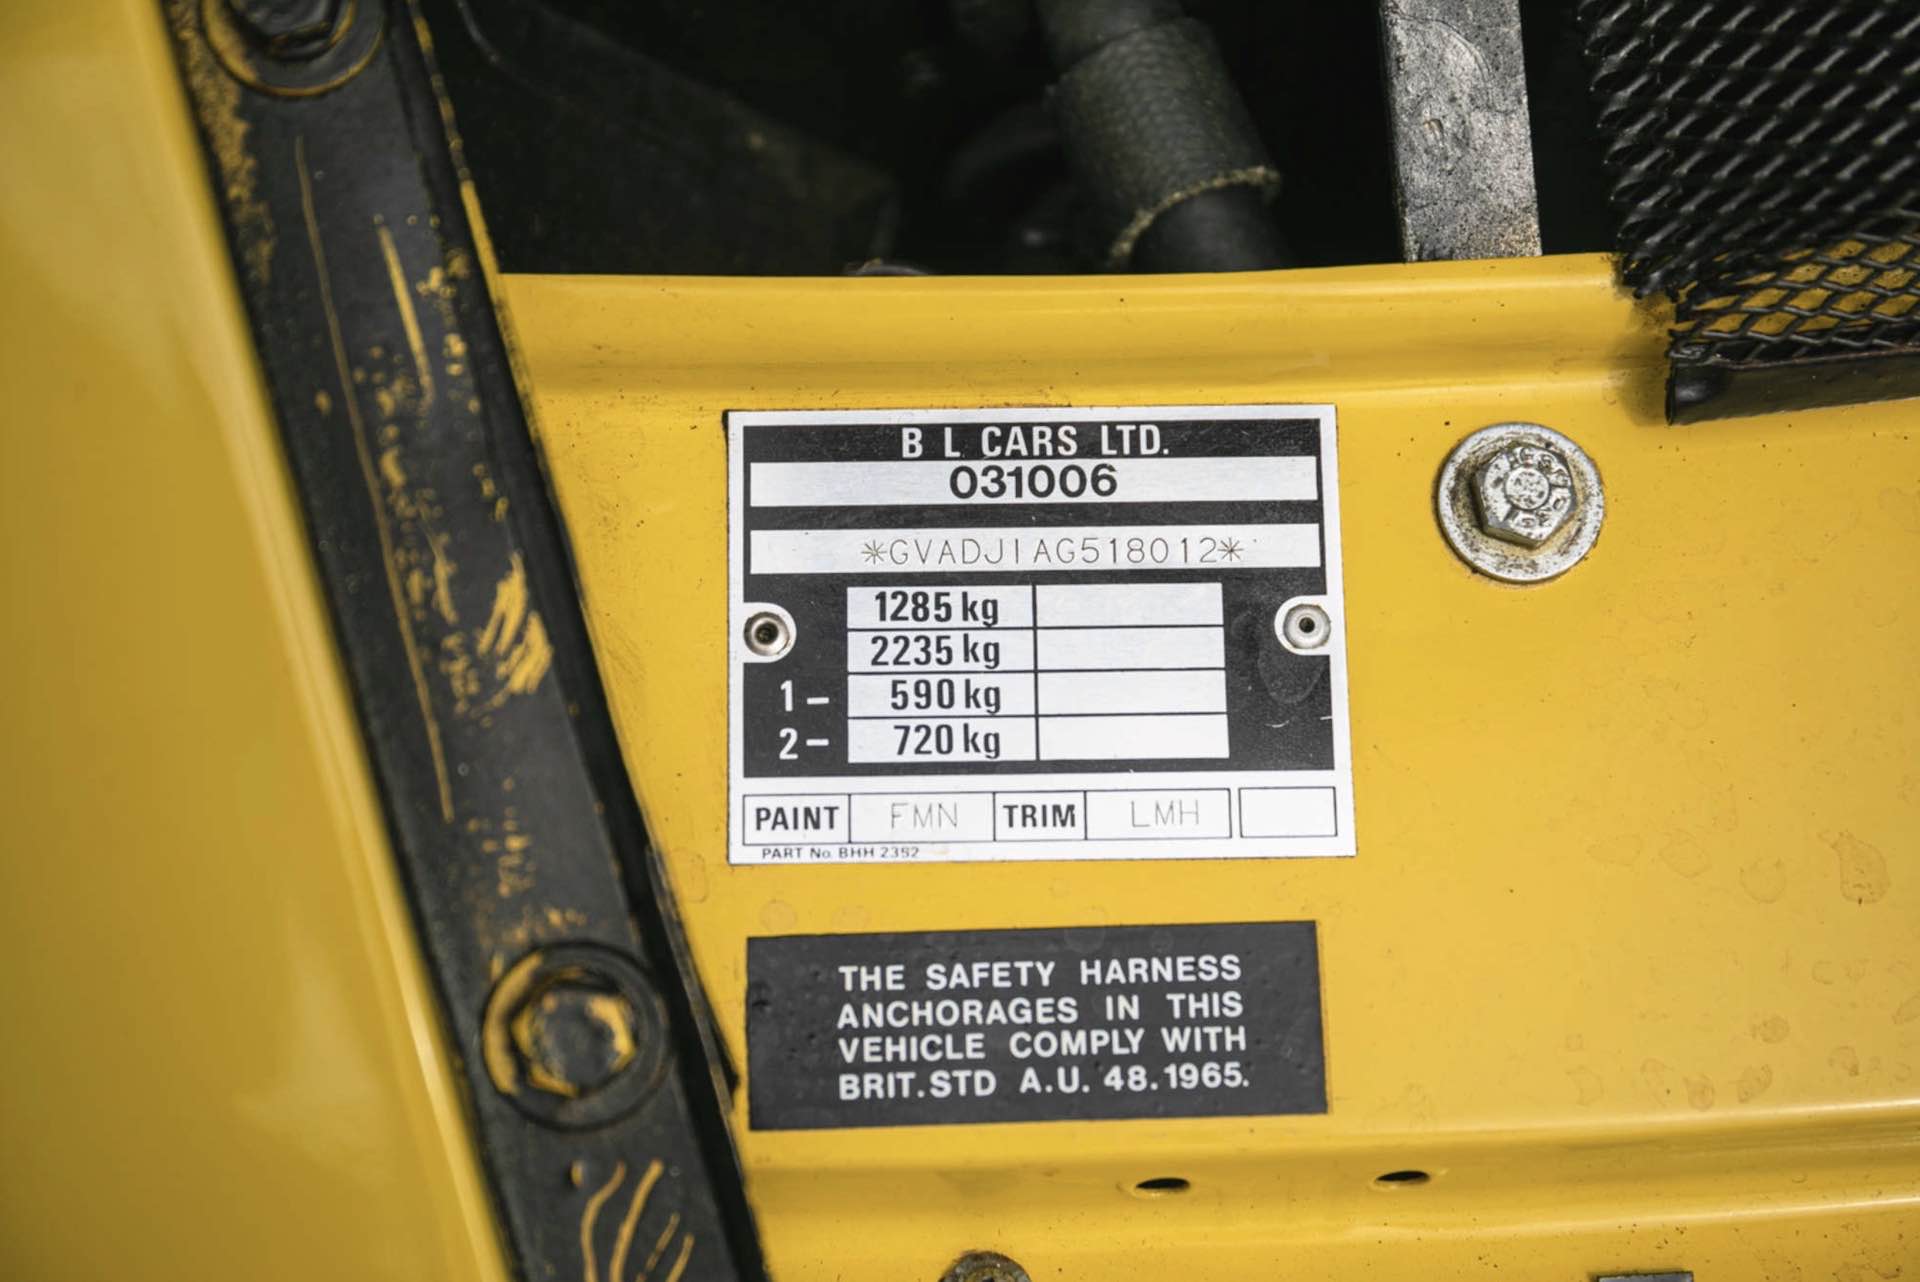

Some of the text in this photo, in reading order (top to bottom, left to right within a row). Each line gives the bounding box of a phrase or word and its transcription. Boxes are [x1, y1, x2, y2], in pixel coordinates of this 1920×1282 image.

[903, 422, 1170, 458] B L CARS LTD.
[949, 464, 1118, 498] 031006
[875, 591, 999, 627] 1285 kg
[871, 633, 1000, 670] 2235 kg
[890, 679, 955, 711] 590
[964, 677, 1001, 714] kg
[894, 724, 955, 757] 720
[964, 723, 1001, 759] kg
[754, 801, 1201, 831] PAINT FMN TRIM LMH
[762, 847, 803, 860] PART
[838, 846, 875, 859] BHH
[838, 955, 1242, 992] THE SAFETY HARNESS
[836, 991, 1244, 1028] ANCHORAGES IN THIS
[838, 1026, 1247, 1063] VEHICLE COMPLY WITH
[1019, 1066, 1091, 1094] A.U.
